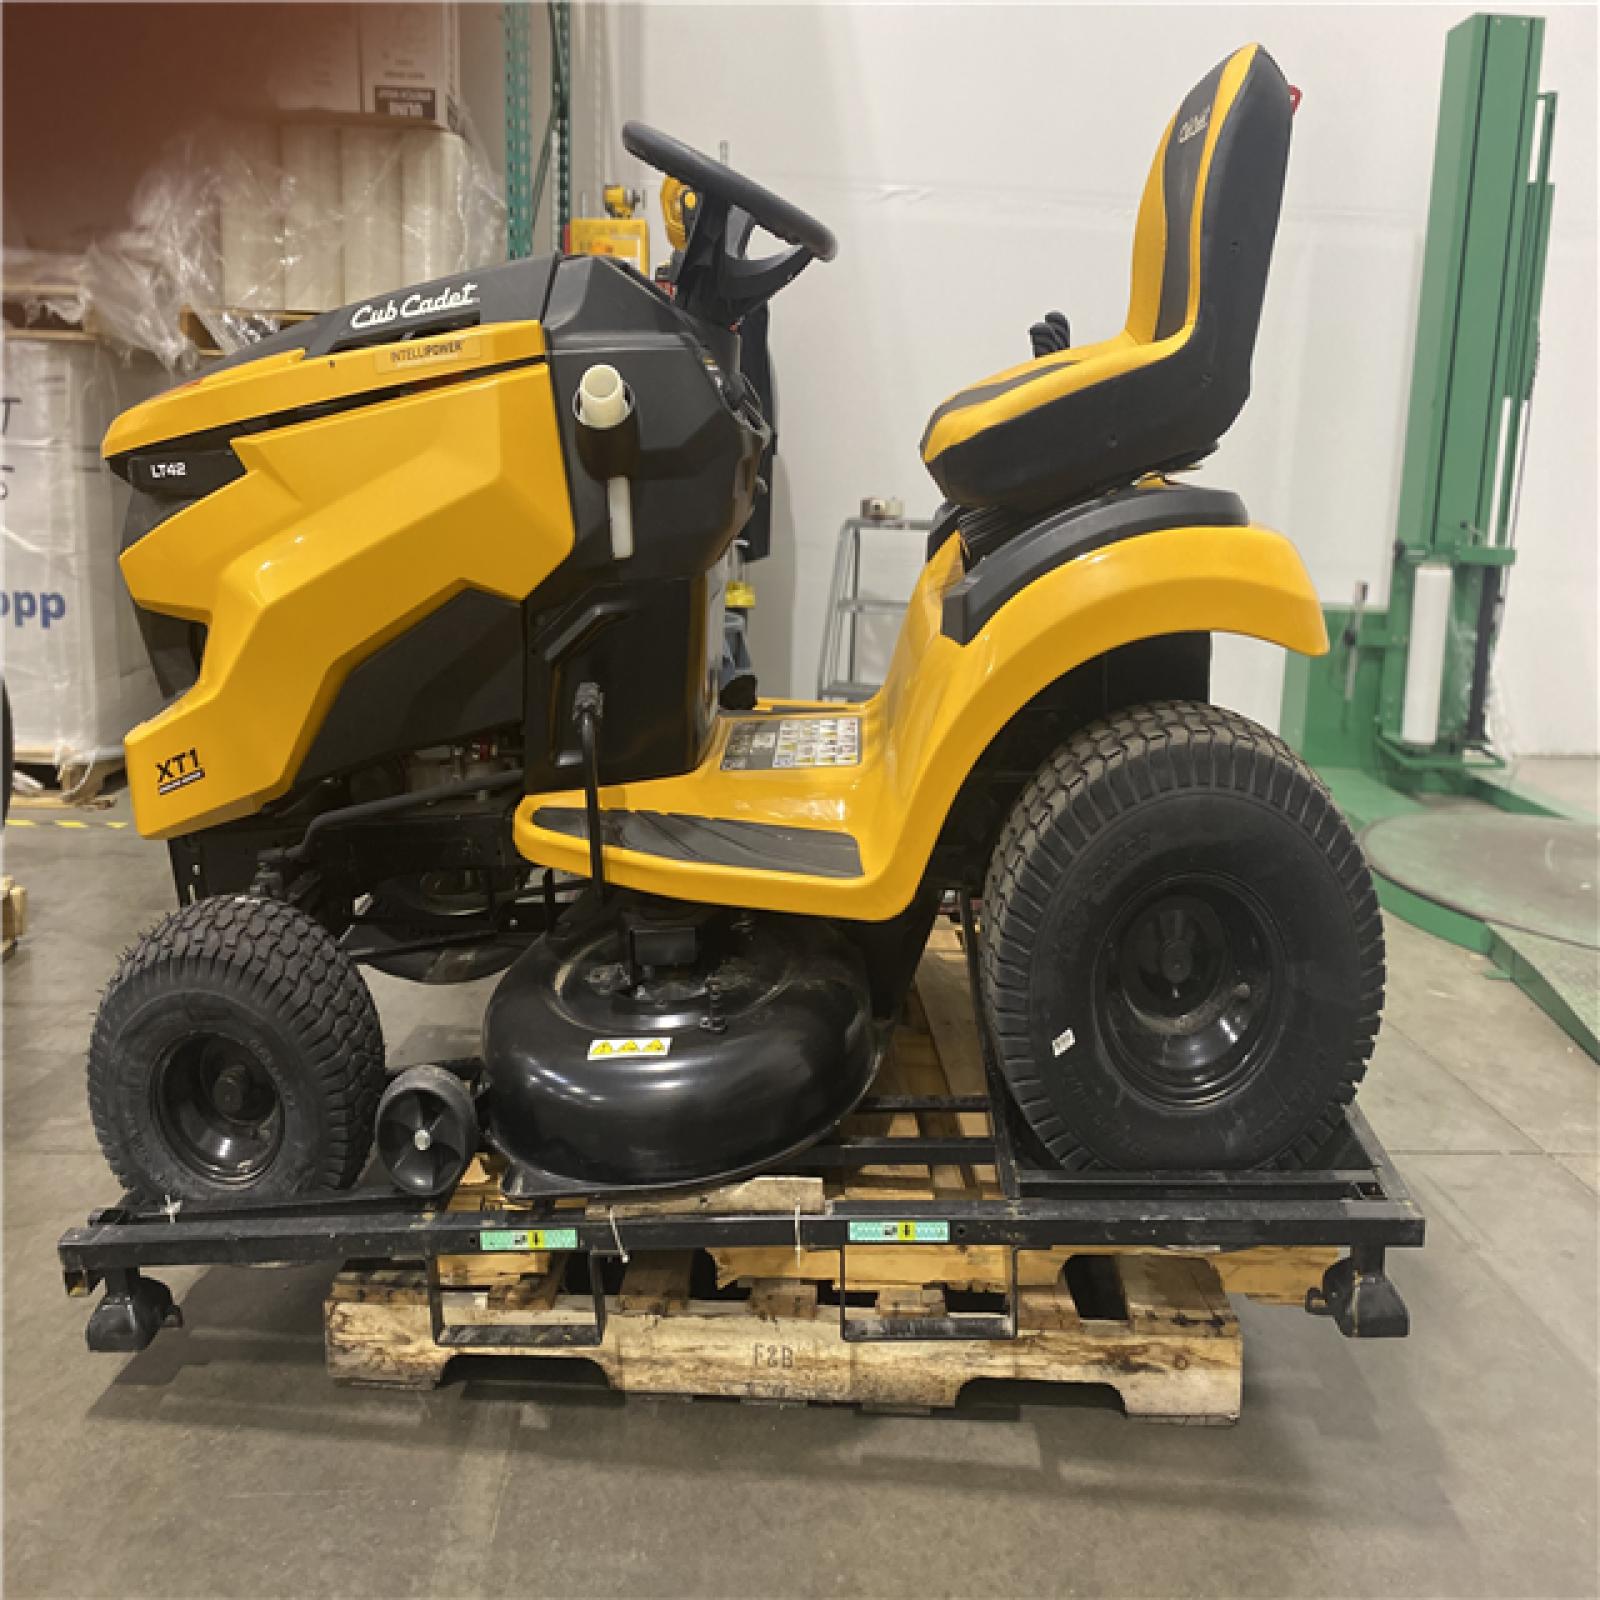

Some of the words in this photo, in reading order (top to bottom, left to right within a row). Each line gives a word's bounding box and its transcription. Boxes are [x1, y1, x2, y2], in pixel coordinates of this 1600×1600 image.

[350, 304, 398, 329] Cub
[400, 282, 479, 318] Cadet
[150, 462, 186, 478] LT42
[156, 747, 199, 782] XT1
